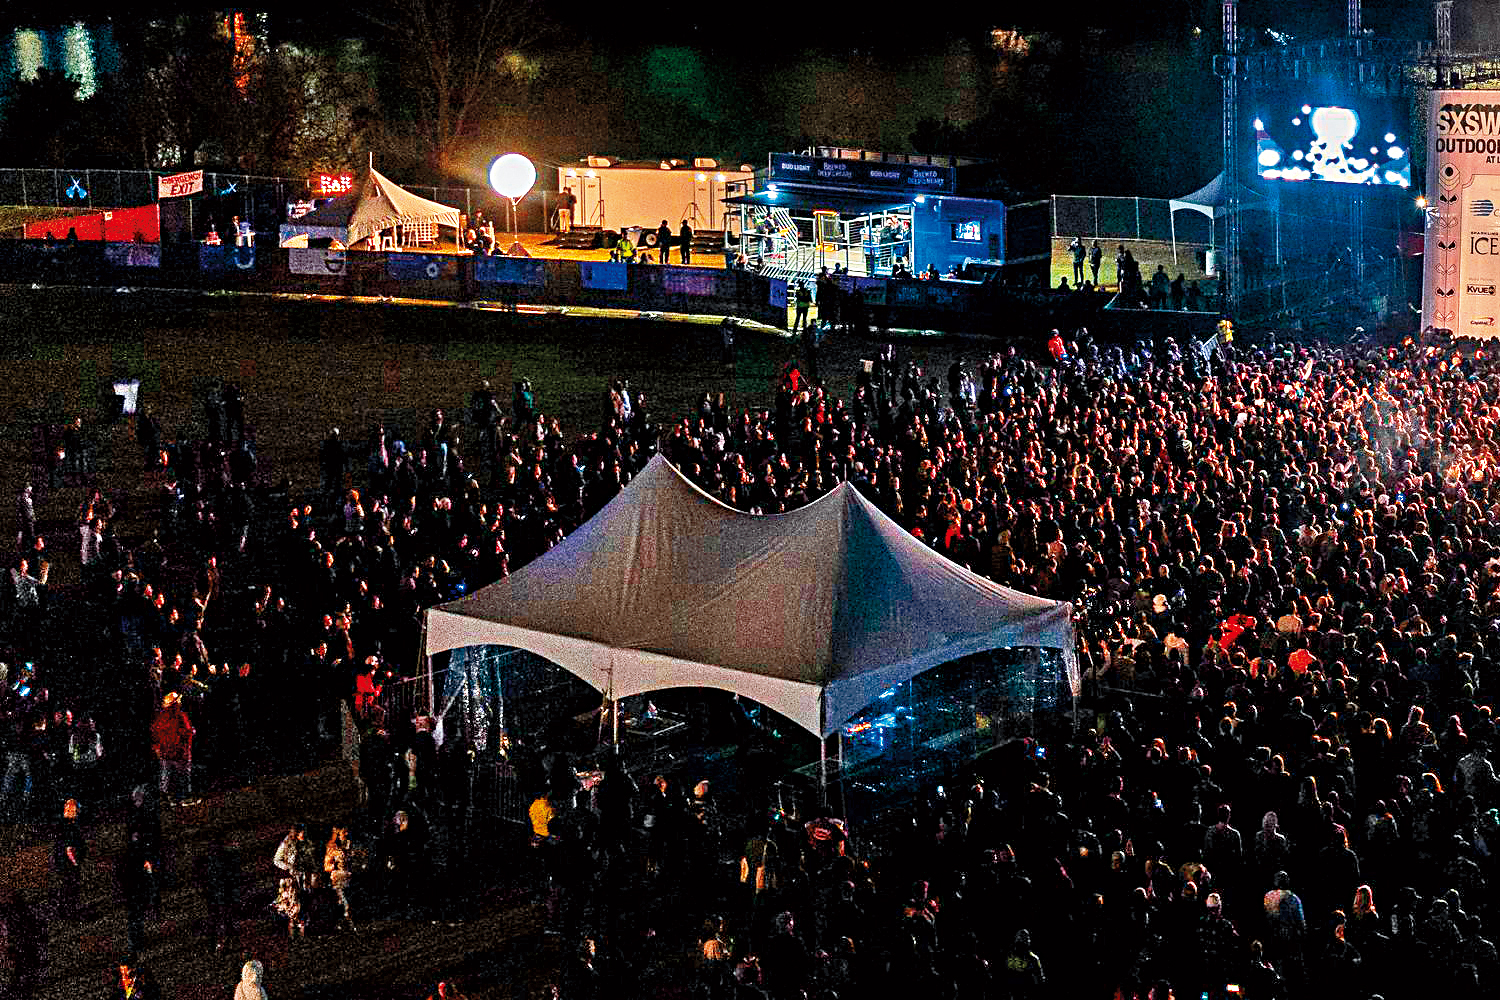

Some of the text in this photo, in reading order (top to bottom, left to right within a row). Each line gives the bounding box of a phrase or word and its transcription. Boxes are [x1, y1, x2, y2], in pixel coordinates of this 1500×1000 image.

[1486, 156, 1496, 164] AT
[170, 181, 195, 196] EXIT
[1470, 236, 1499, 256] ICE
[1467, 285, 1489, 294] KVUE
